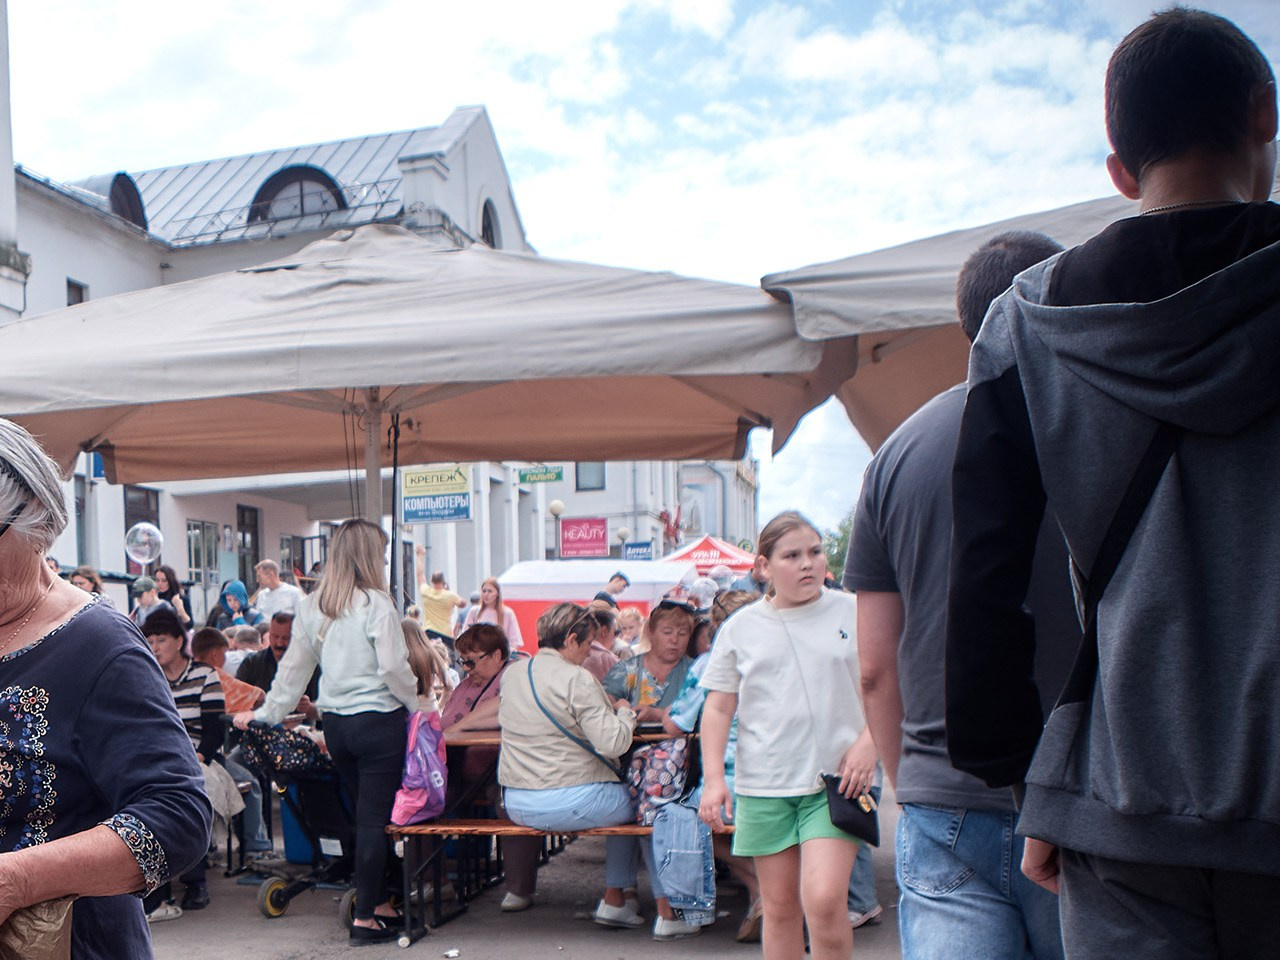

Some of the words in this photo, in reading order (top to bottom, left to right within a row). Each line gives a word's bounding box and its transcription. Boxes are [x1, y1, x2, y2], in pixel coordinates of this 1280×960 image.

[410, 474, 457, 485] КРЕПЕЖ
[526, 472, 557, 481] ПАЛЬТО
[404, 495, 469, 511] КОМПЬЮТЕРЫ
